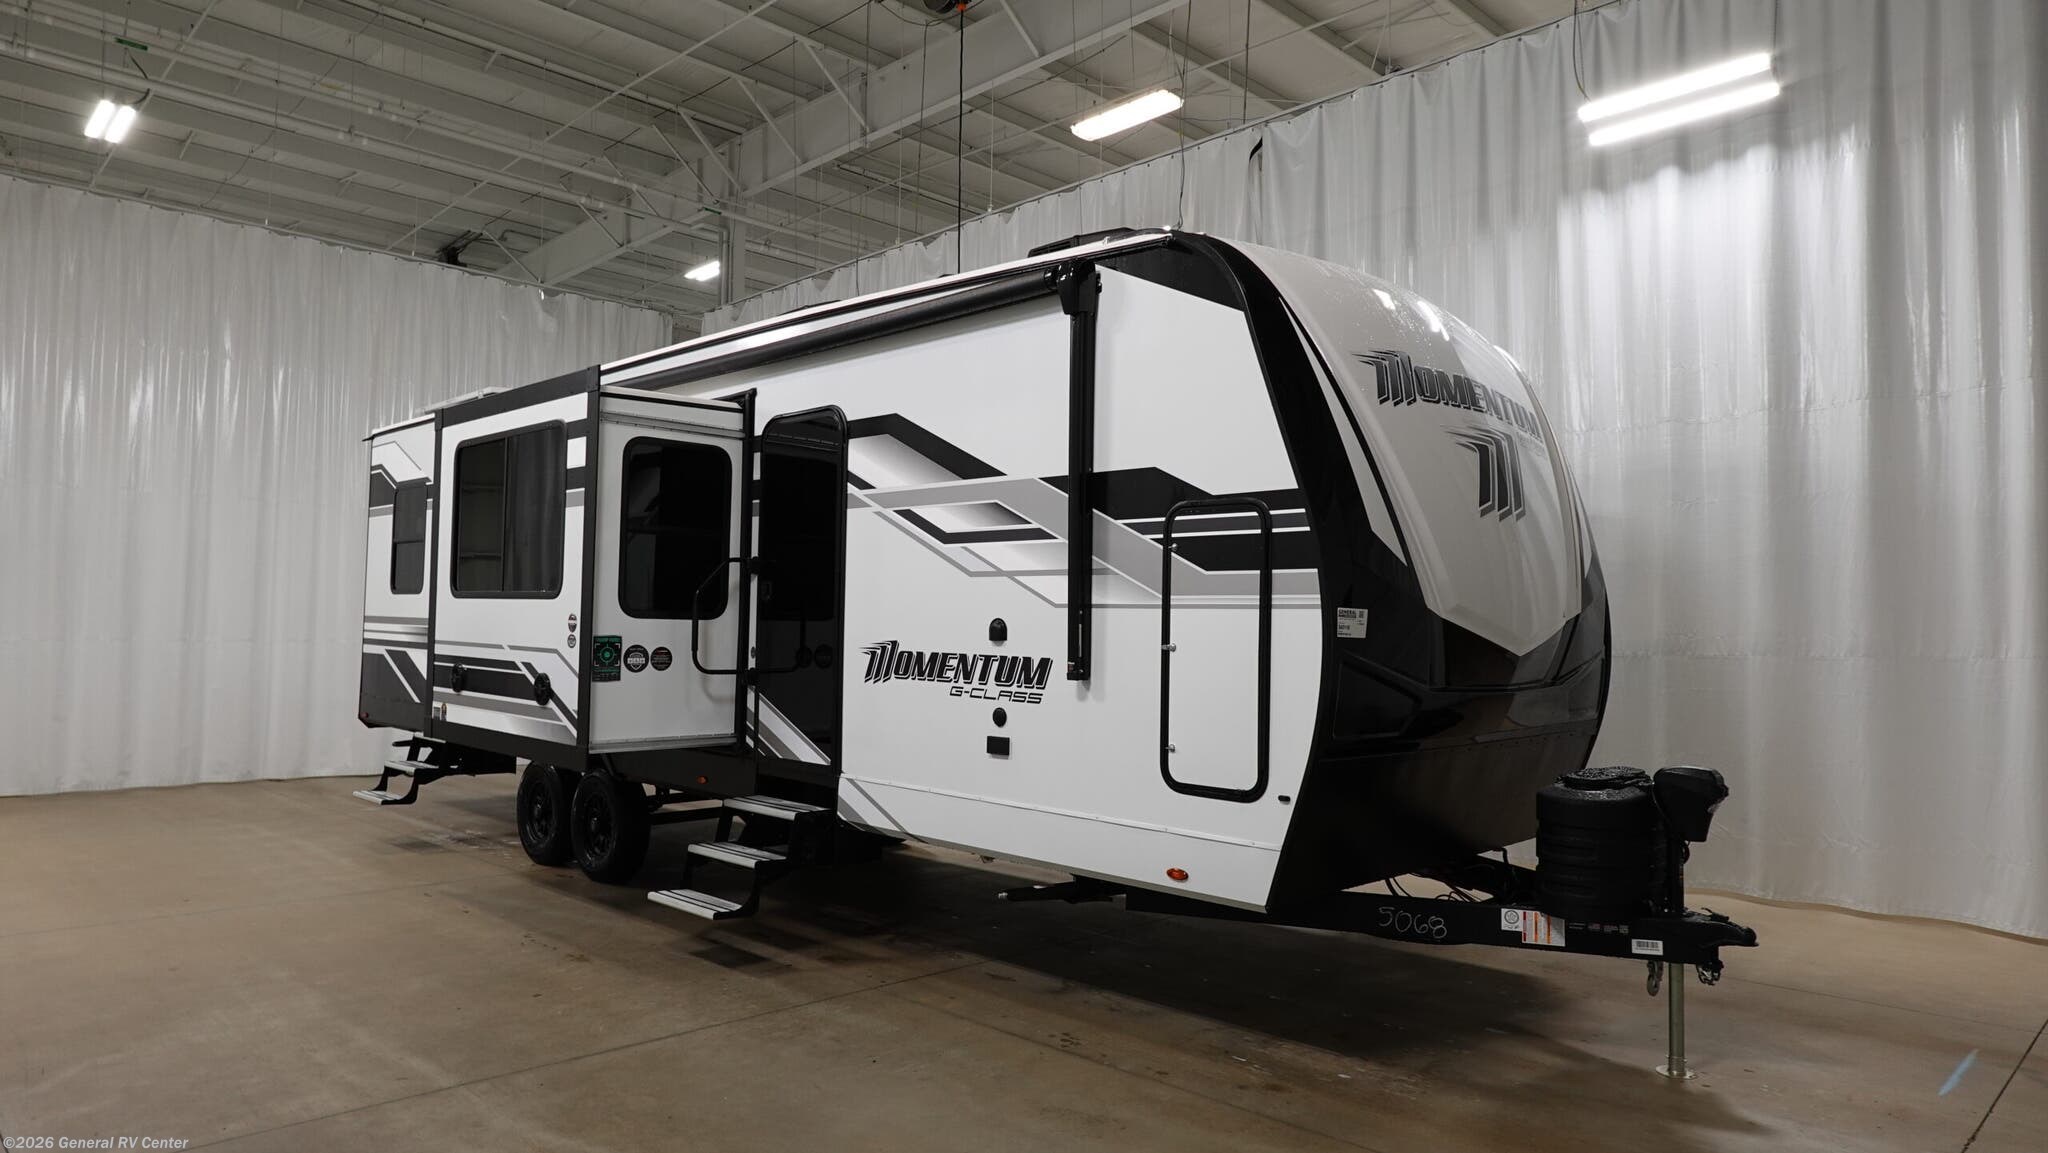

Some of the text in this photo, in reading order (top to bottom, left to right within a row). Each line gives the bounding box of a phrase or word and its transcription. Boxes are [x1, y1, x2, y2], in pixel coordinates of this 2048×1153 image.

[1352, 350, 1545, 445] MOMENTUM
[859, 640, 1053, 690] MOMENTUM
[949, 686, 1044, 704] G-CLASS
[1378, 906, 1447, 939] 5068
